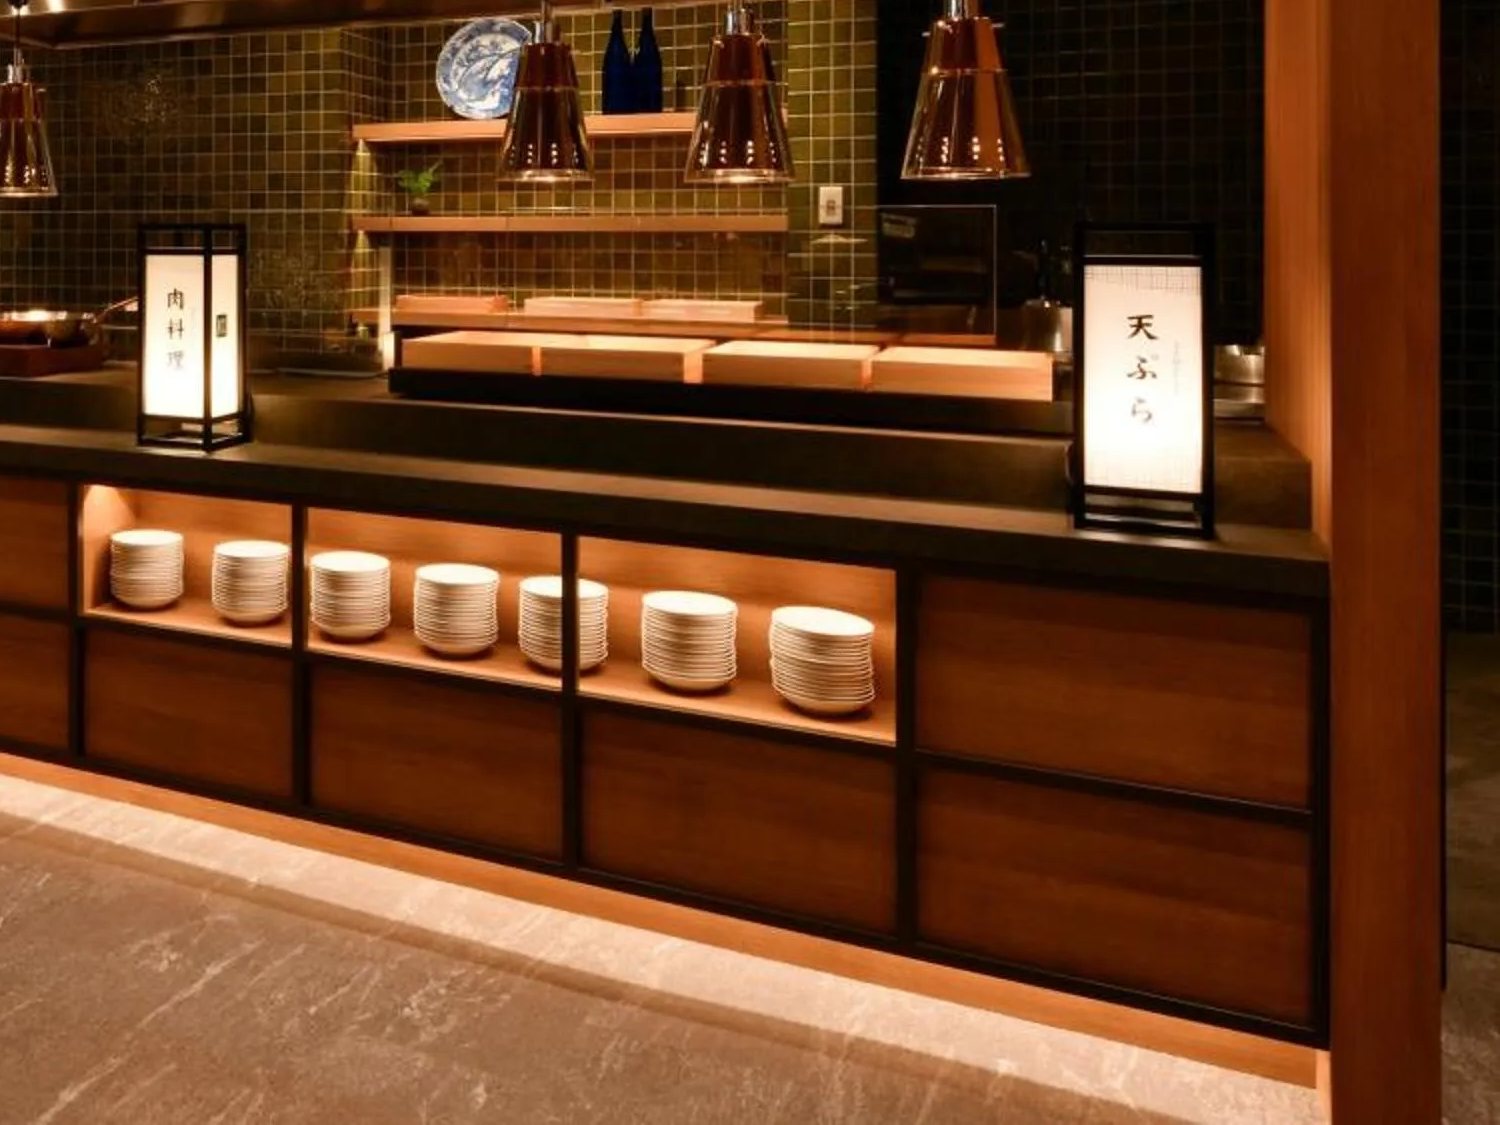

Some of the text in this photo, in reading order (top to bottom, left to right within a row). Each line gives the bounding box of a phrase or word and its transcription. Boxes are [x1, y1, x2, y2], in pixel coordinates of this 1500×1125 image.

[166, 287, 185, 371] 肉料理
[1126, 313, 1159, 426] 天ぷら
